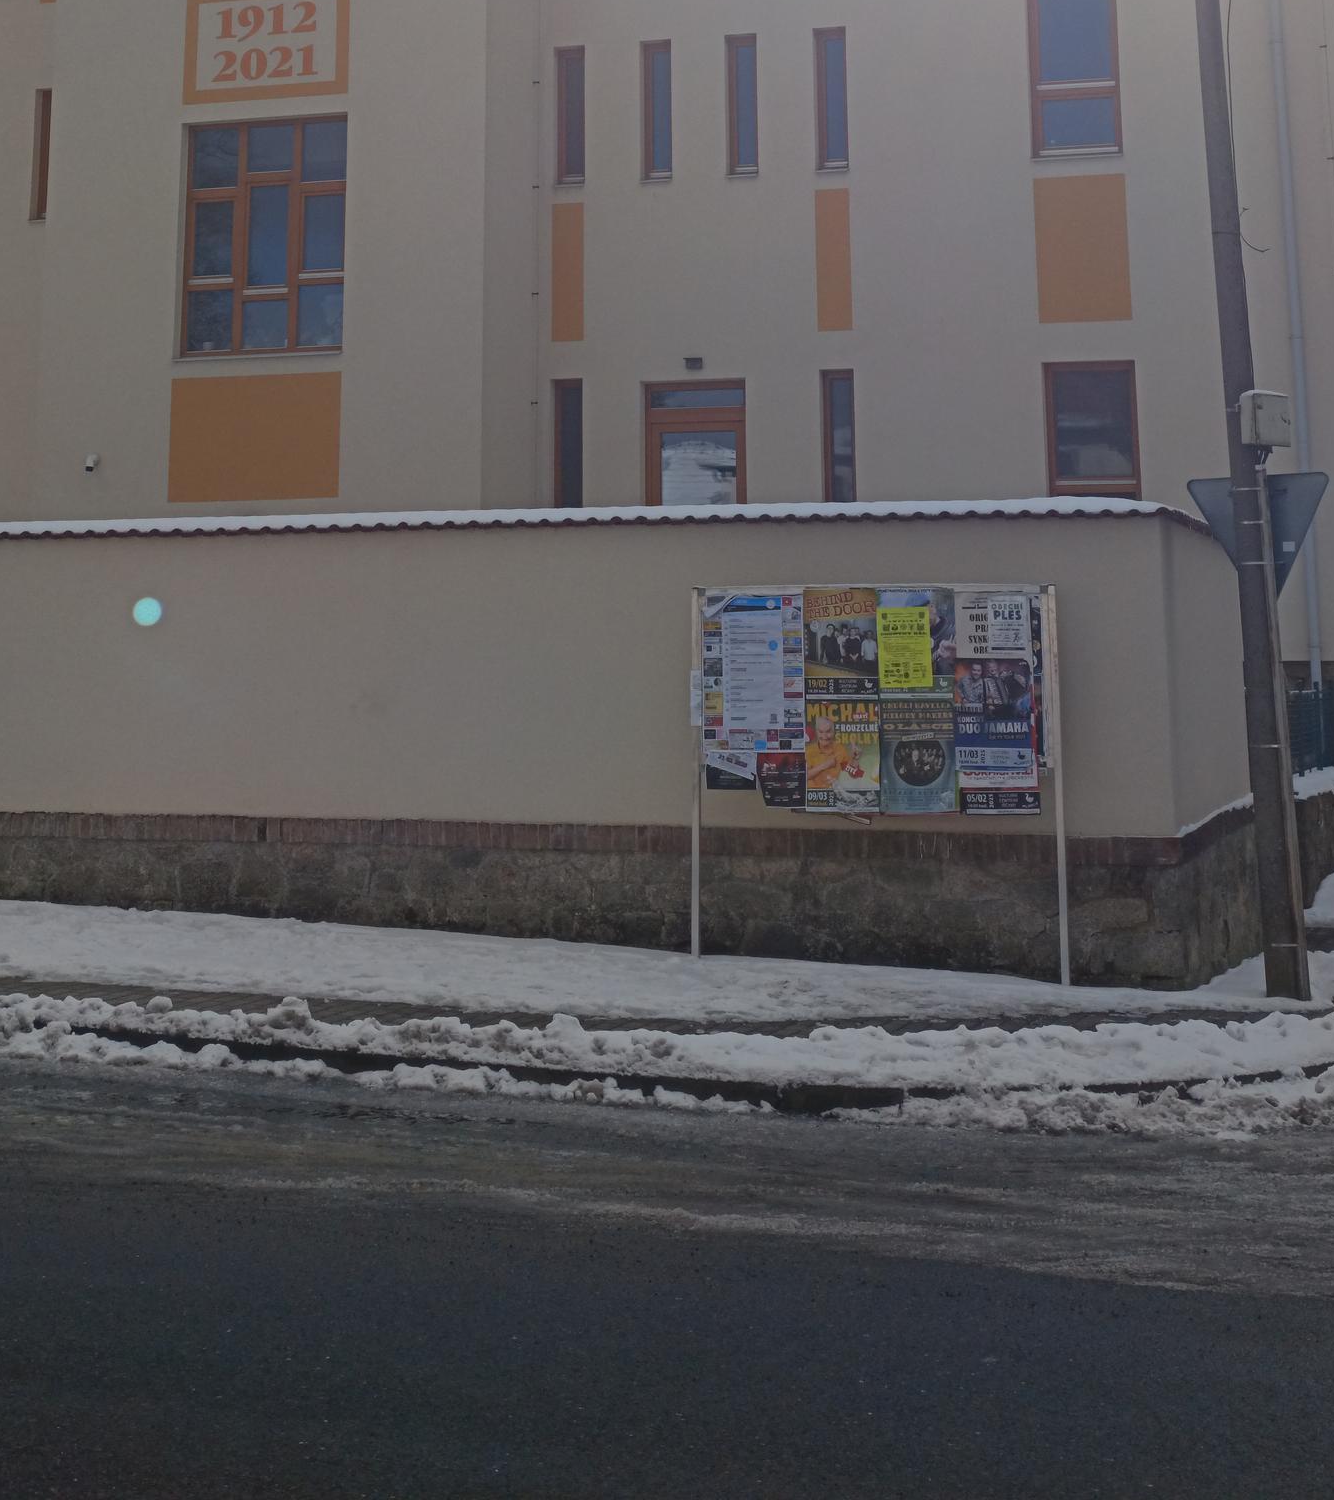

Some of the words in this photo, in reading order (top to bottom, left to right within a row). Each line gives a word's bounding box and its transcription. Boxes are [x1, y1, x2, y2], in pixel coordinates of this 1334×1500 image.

[215, 1, 317, 42] 1912
[211, 44, 318, 82] 2021
[807, 592, 853, 608] BEHIND
[809, 605, 830, 618] THE
[834, 601, 877, 617] DOOR
[993, 610, 1022, 621] PLES
[808, 679, 827, 689] 19/02
[806, 702, 877, 722] MICHAL
[959, 723, 981, 734] DUO
[959, 749, 979, 759] 11/03
[808, 792, 828, 801] 09/03
[966, 794, 988, 803] 05/02
